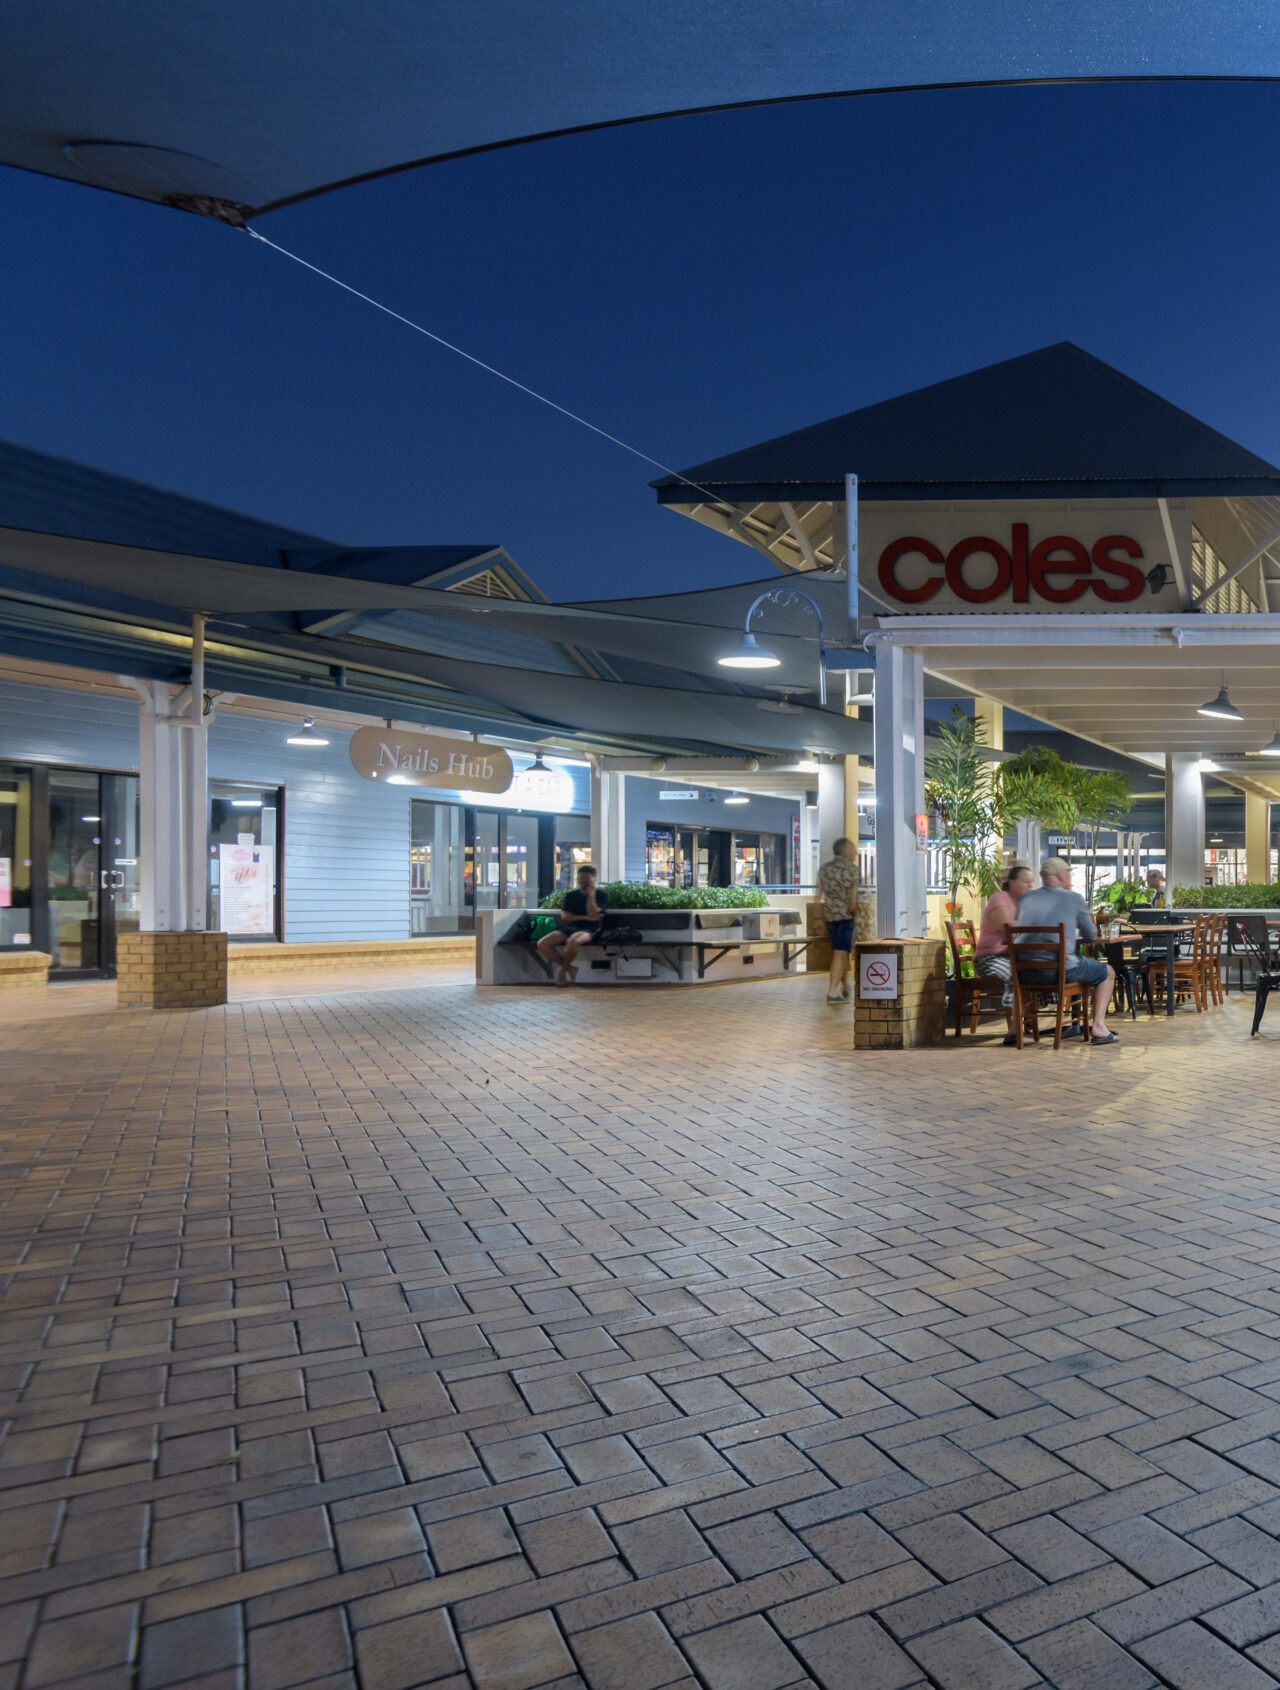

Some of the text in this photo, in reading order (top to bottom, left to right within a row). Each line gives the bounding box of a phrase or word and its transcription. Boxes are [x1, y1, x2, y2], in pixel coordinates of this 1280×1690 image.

[877, 523, 1146, 604] coles
[376, 743, 494, 780] Nails Hub
